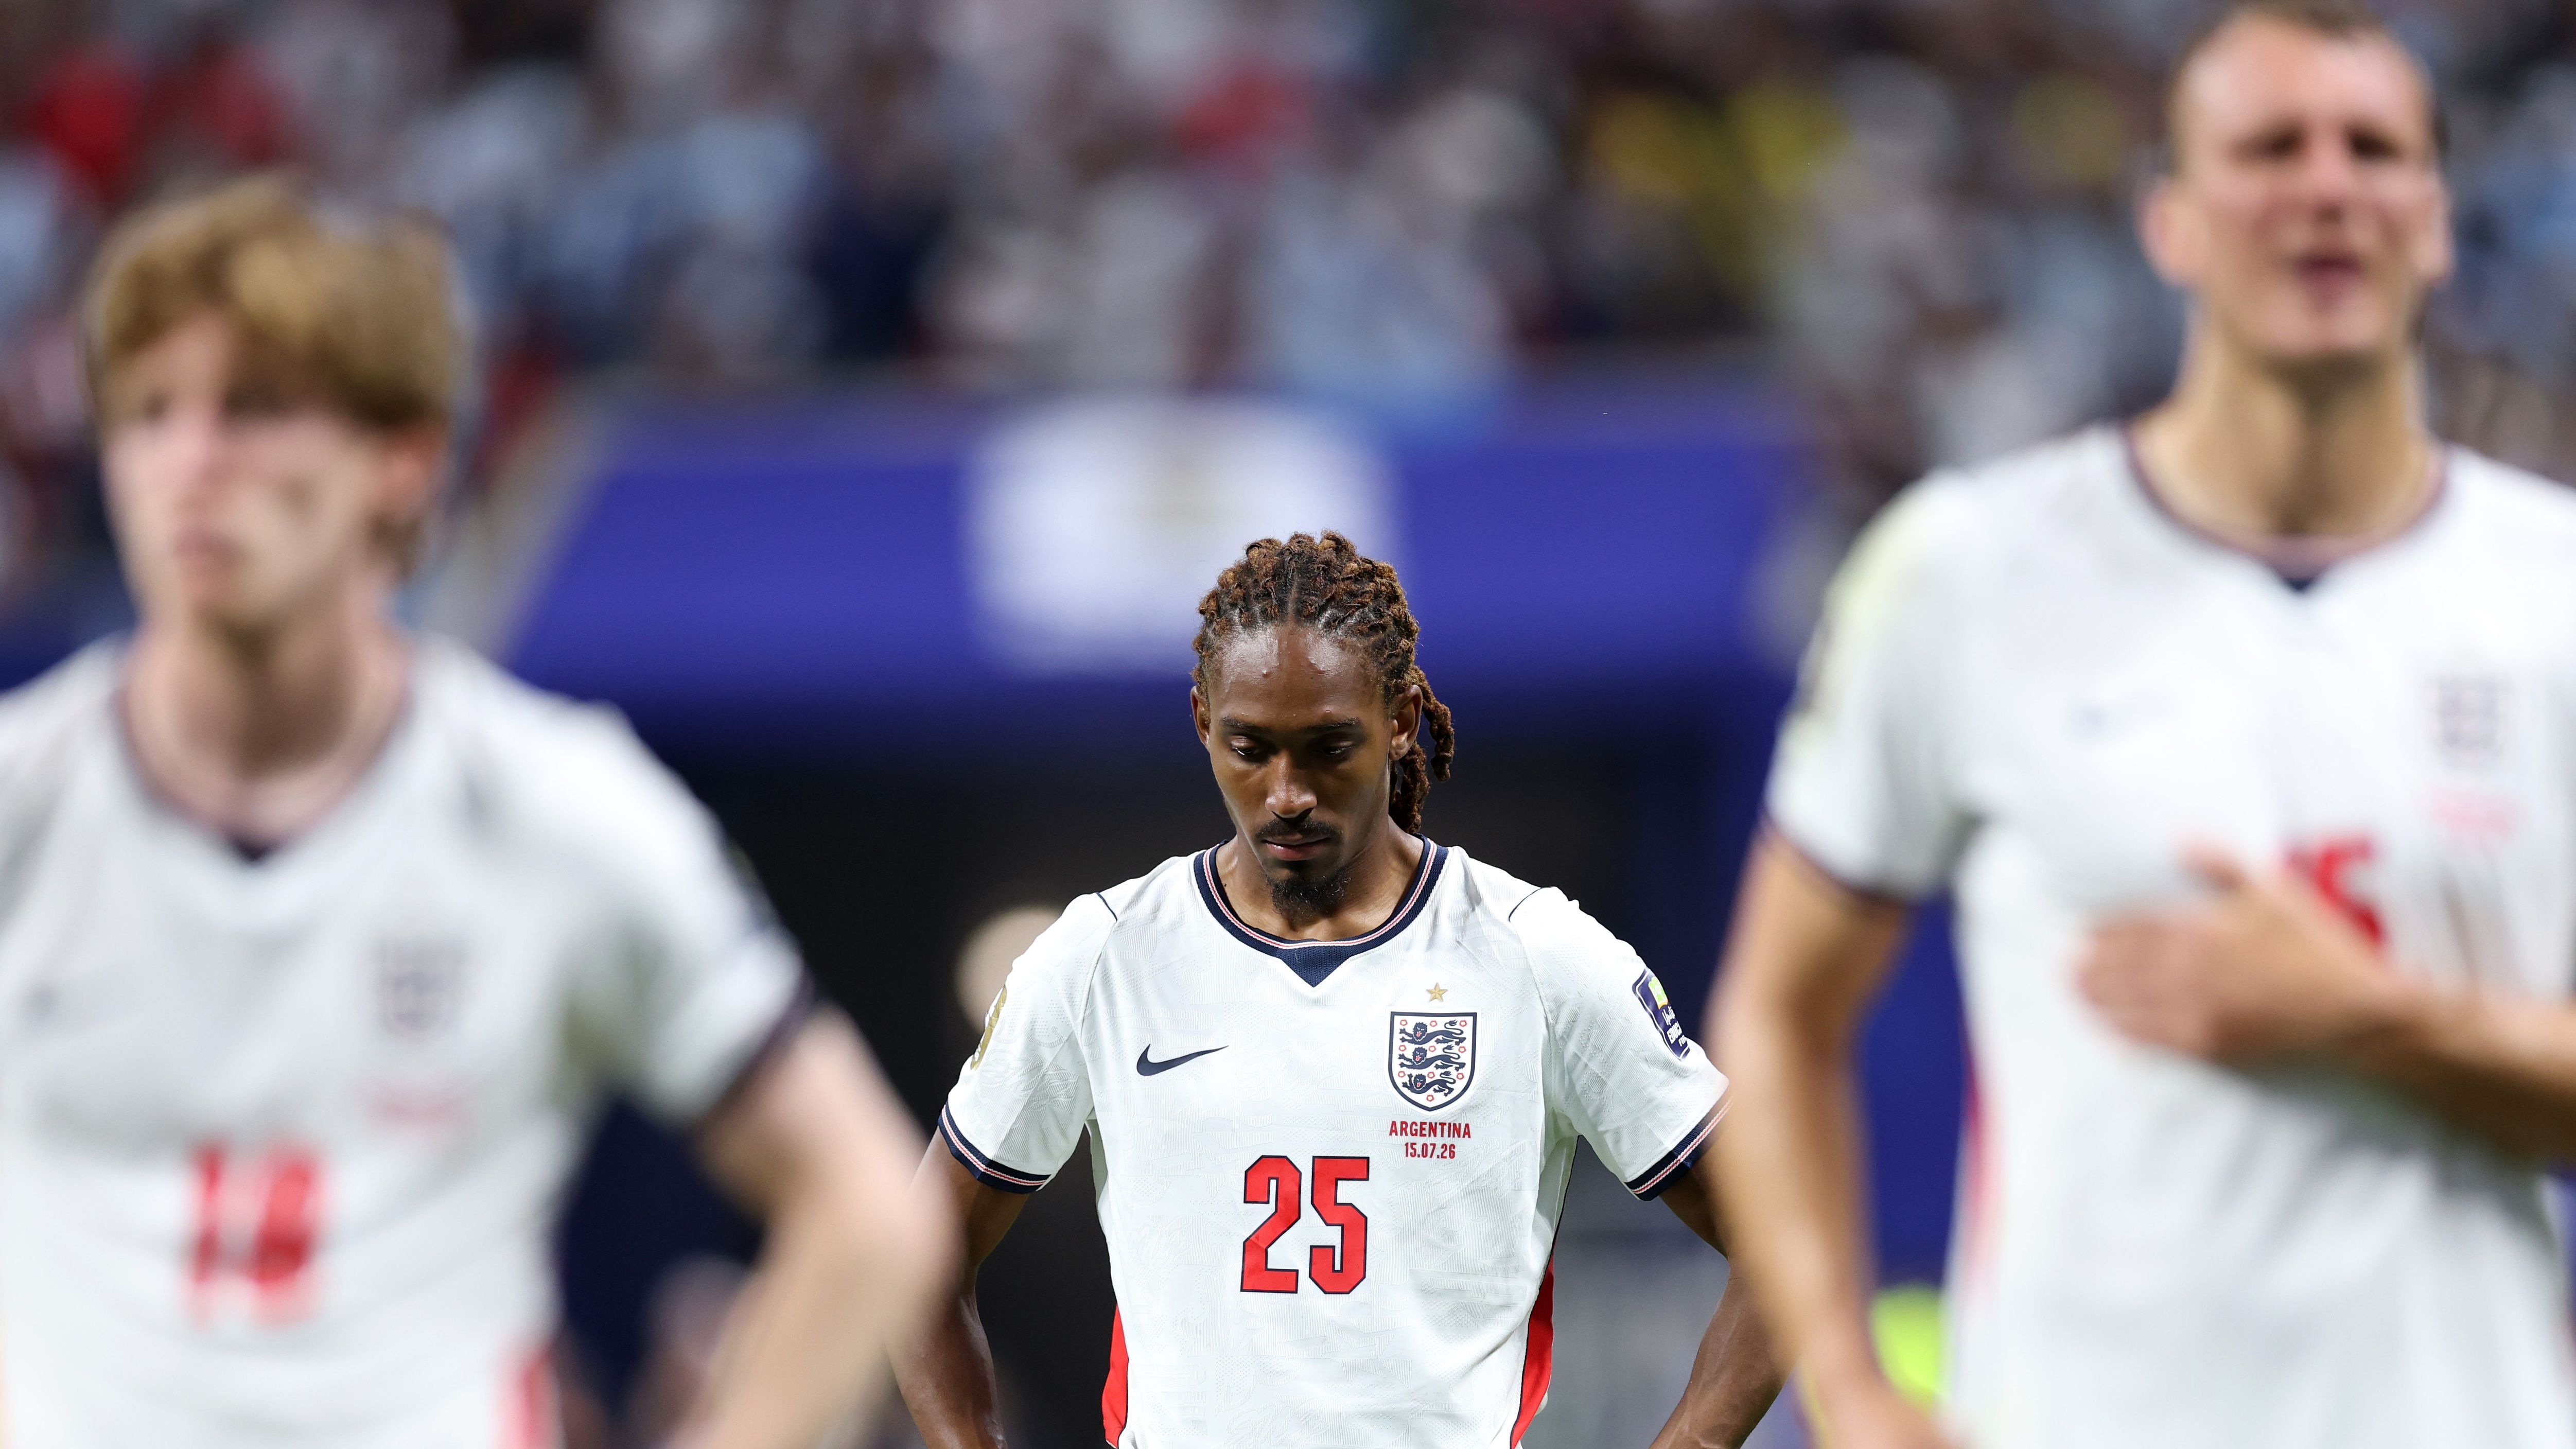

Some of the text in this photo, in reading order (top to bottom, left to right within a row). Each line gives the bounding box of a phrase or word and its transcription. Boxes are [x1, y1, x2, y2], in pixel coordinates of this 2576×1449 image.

[1389, 1121, 1471, 1138] ARGENTINA
[1405, 1142, 1456, 1159] 15.07.26
[1240, 1155, 1370, 1295] 25
